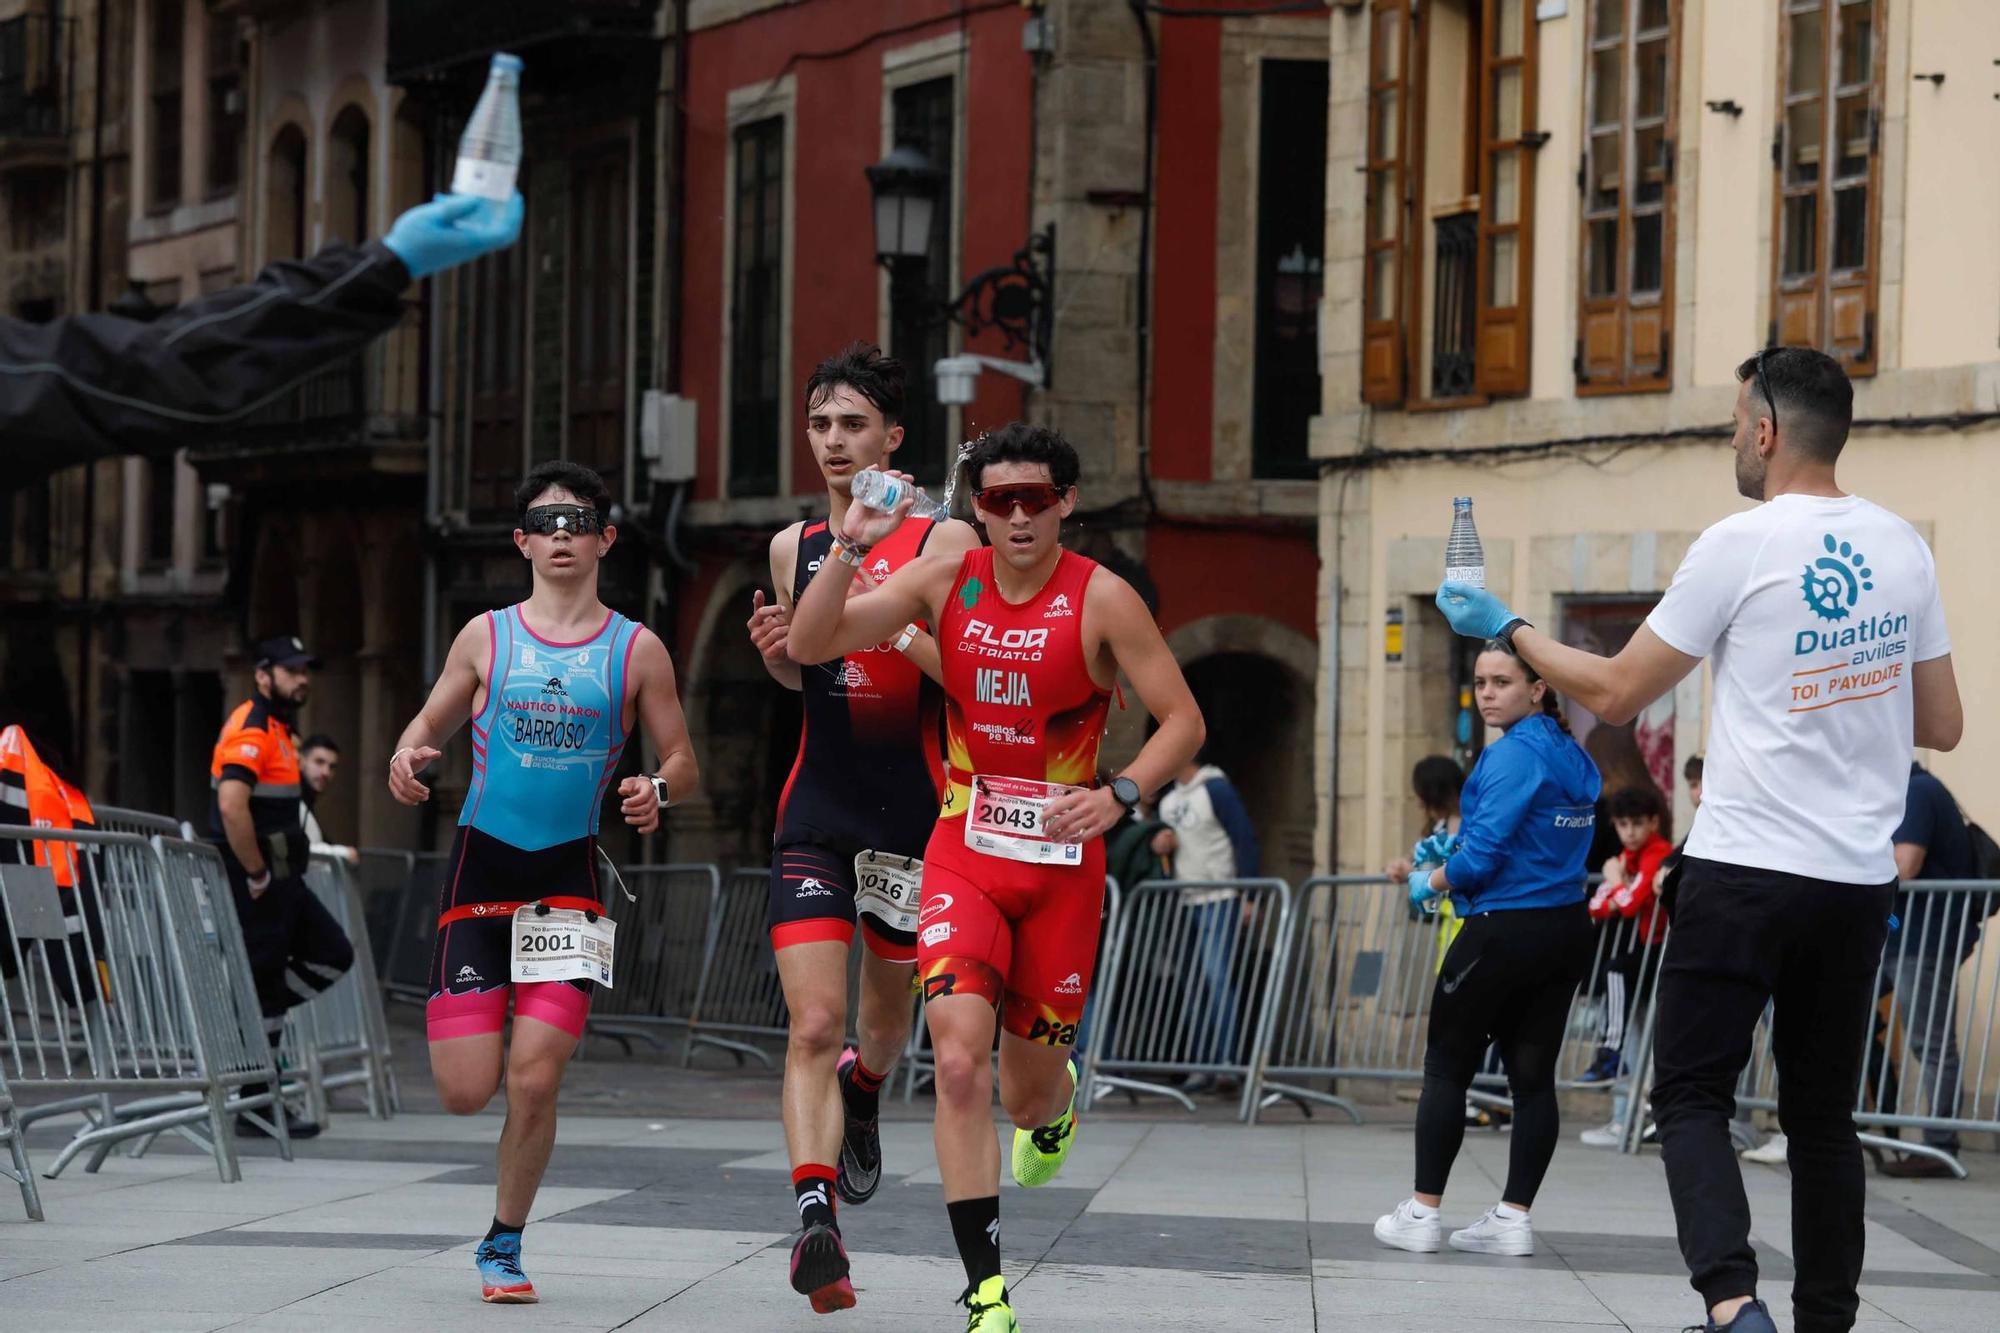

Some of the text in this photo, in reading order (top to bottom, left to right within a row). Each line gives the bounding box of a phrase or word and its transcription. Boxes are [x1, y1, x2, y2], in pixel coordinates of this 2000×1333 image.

[963, 618, 1049, 648] FLOR
[1795, 611, 1907, 655] Duatlón
[976, 668, 1032, 707] MEJIA
[1791, 662, 1903, 700] TOI P'AYUDATE
[507, 701, 601, 718] NAUTICO NARON
[515, 717, 586, 749] BARROSO
[978, 804, 1036, 830] 2043
[521, 934, 575, 952] 2001
